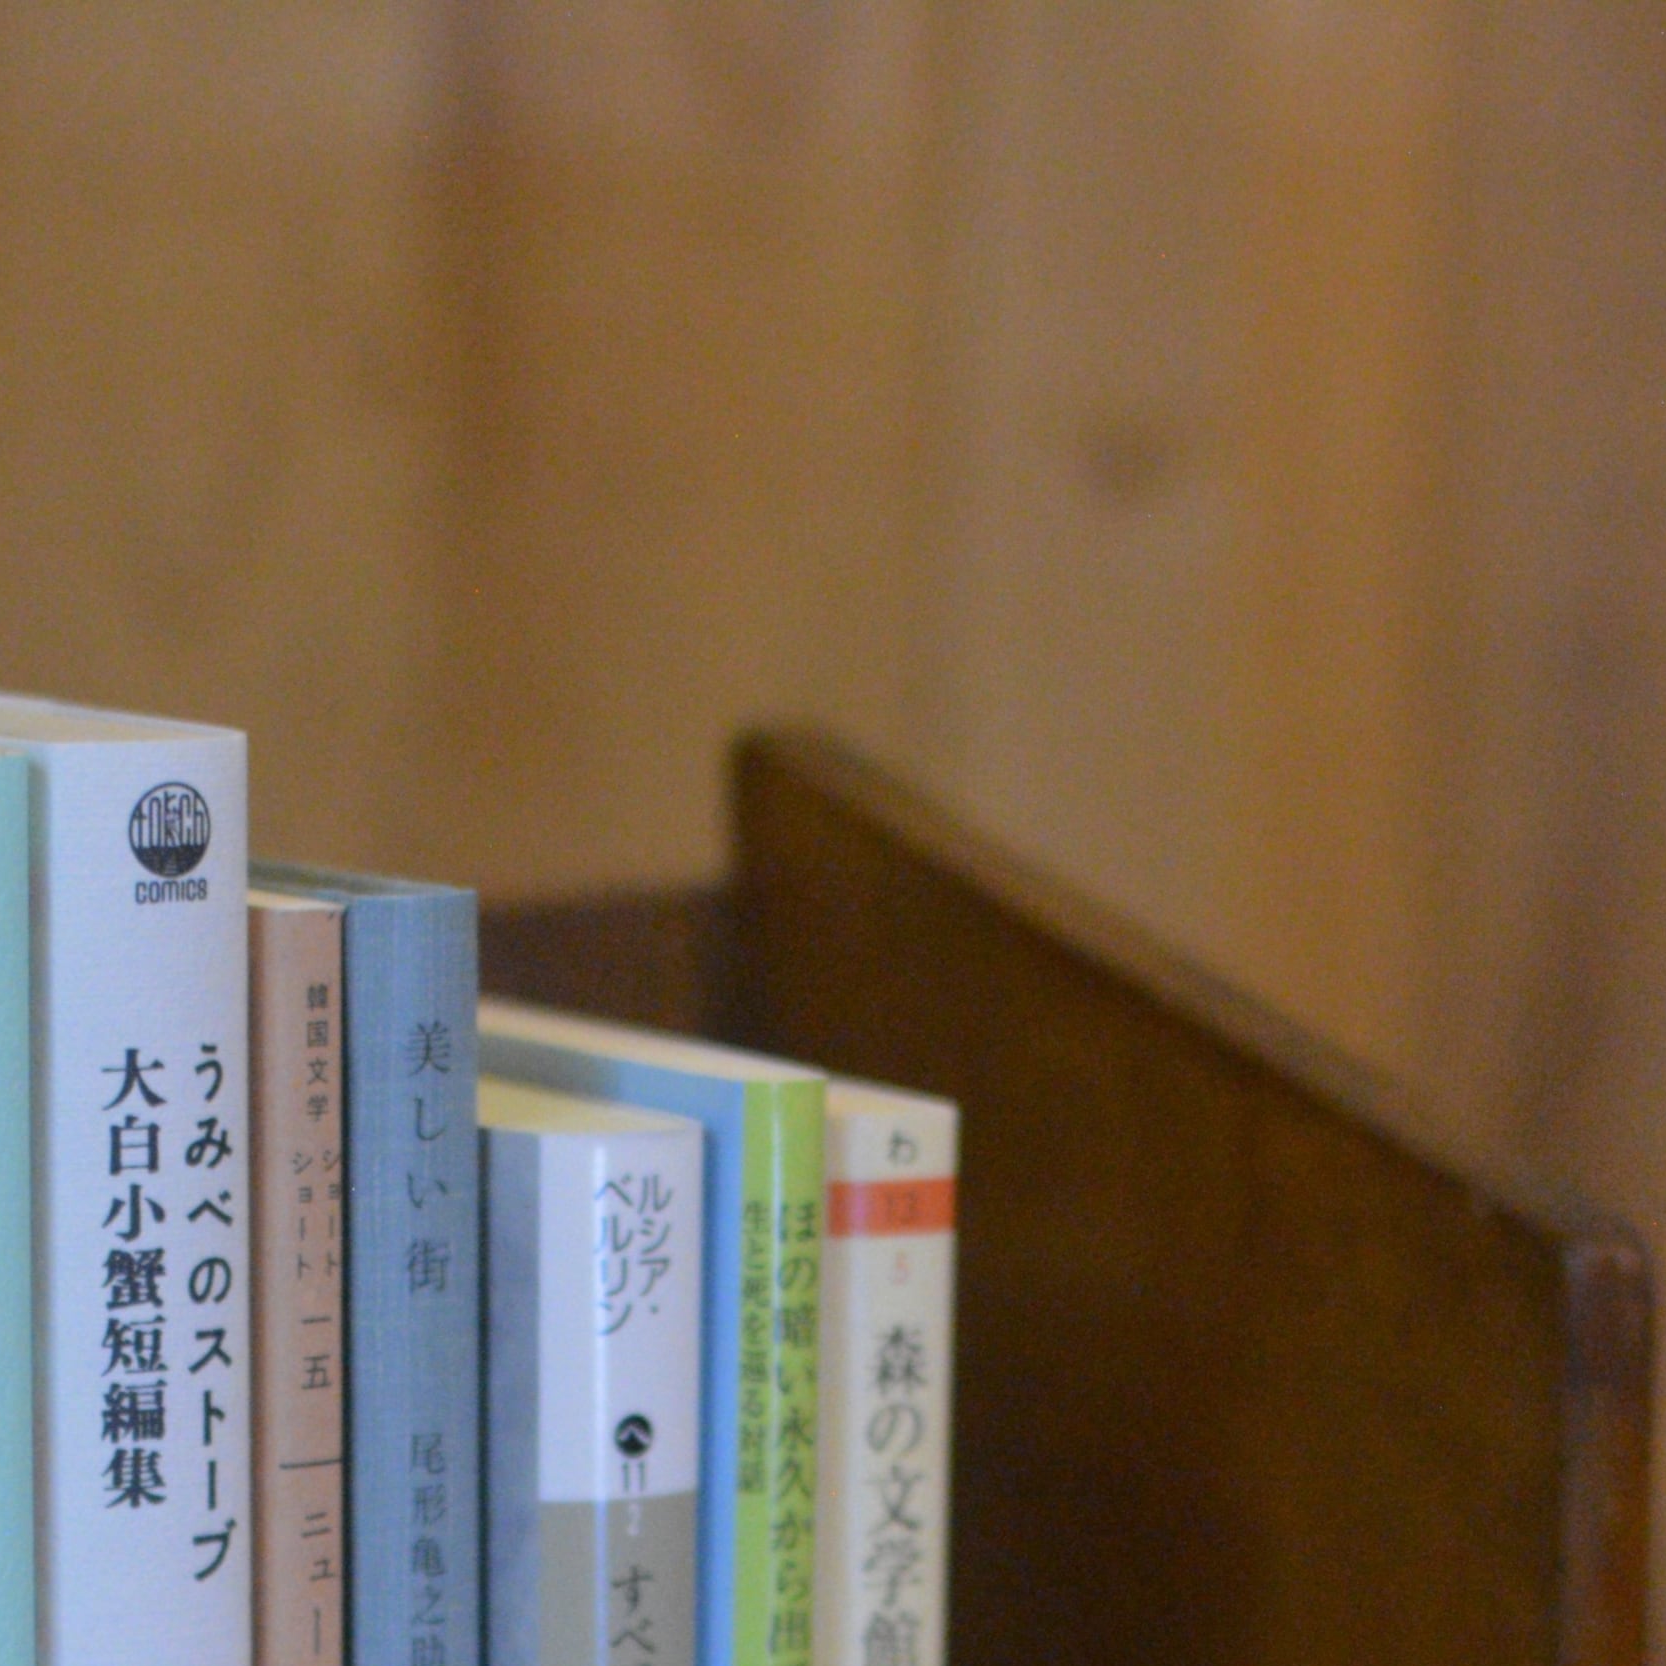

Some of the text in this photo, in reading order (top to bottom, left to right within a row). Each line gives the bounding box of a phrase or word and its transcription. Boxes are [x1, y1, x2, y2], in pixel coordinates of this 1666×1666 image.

[100, 1047, 169, 1509] 大白小蟹短編集
[184, 1043, 237, 1581] うみべのストーブ
[406, 1019, 452, 1293] 美しい街
